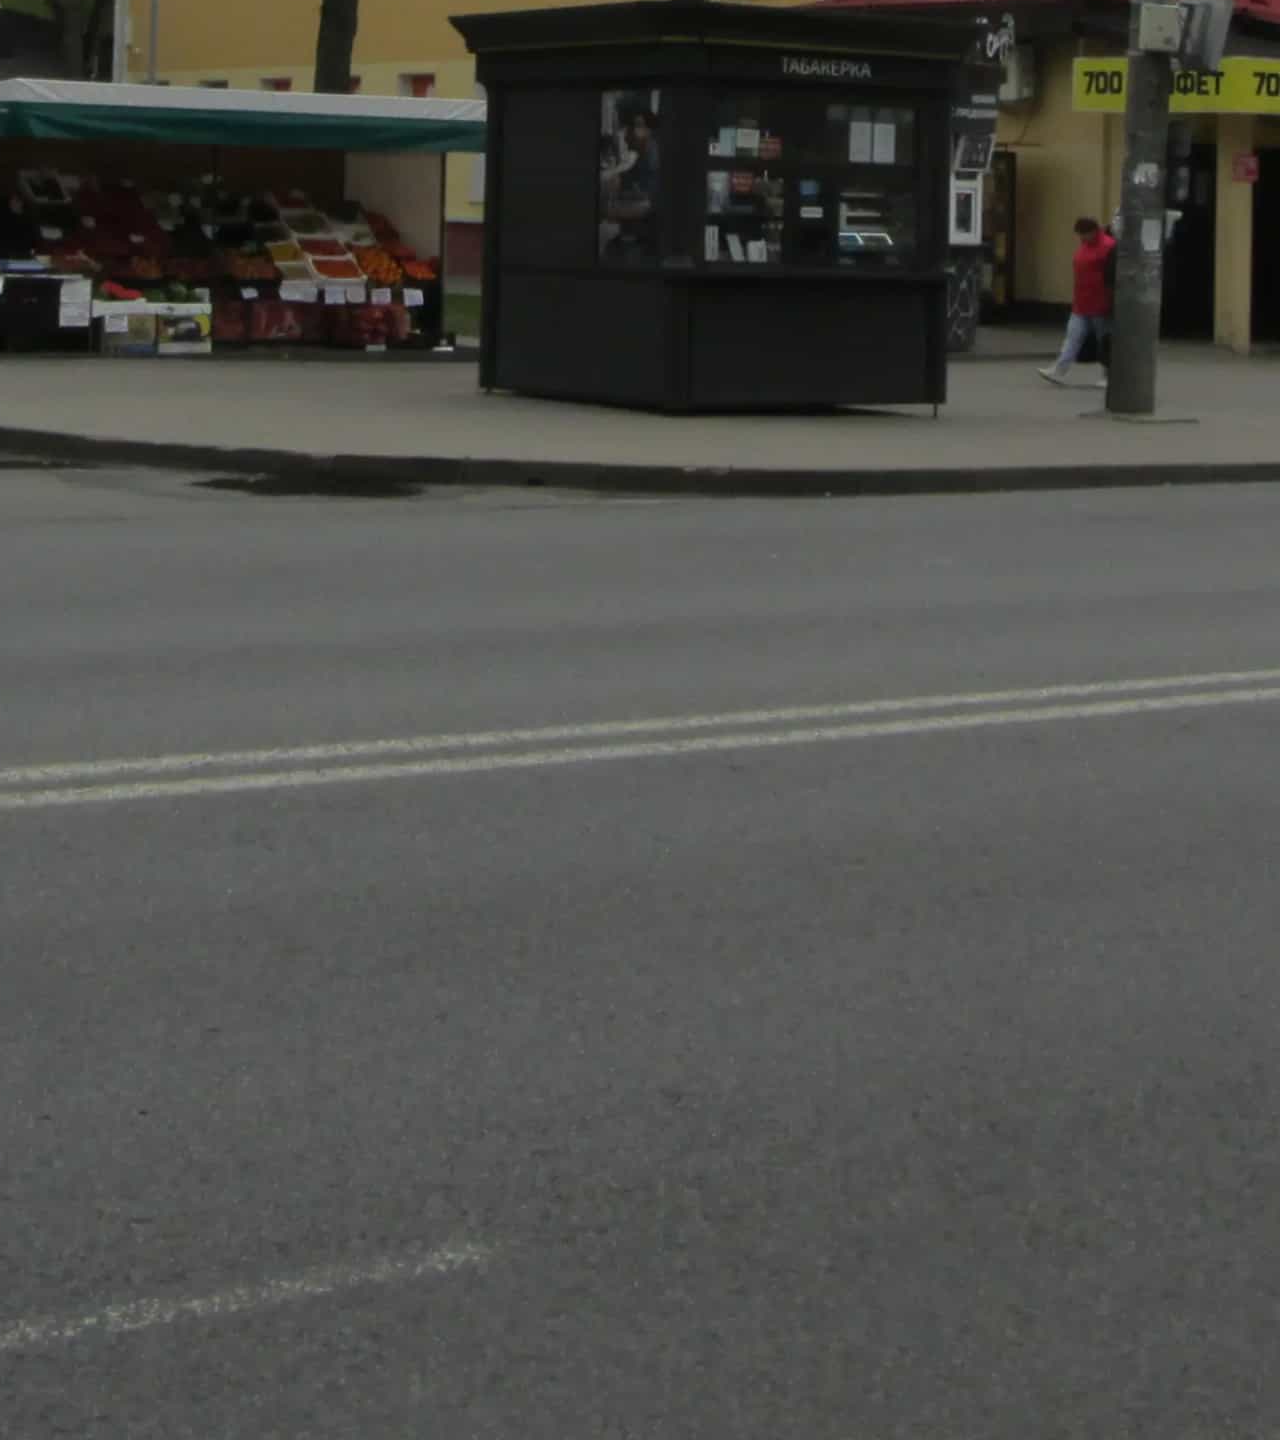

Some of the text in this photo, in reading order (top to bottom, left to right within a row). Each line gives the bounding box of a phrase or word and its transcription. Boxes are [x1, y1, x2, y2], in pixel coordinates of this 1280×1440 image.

[781, 56, 872, 80] ТАБАКЕРКА
[1083, 70, 1225, 96] 700 ФЕТ
